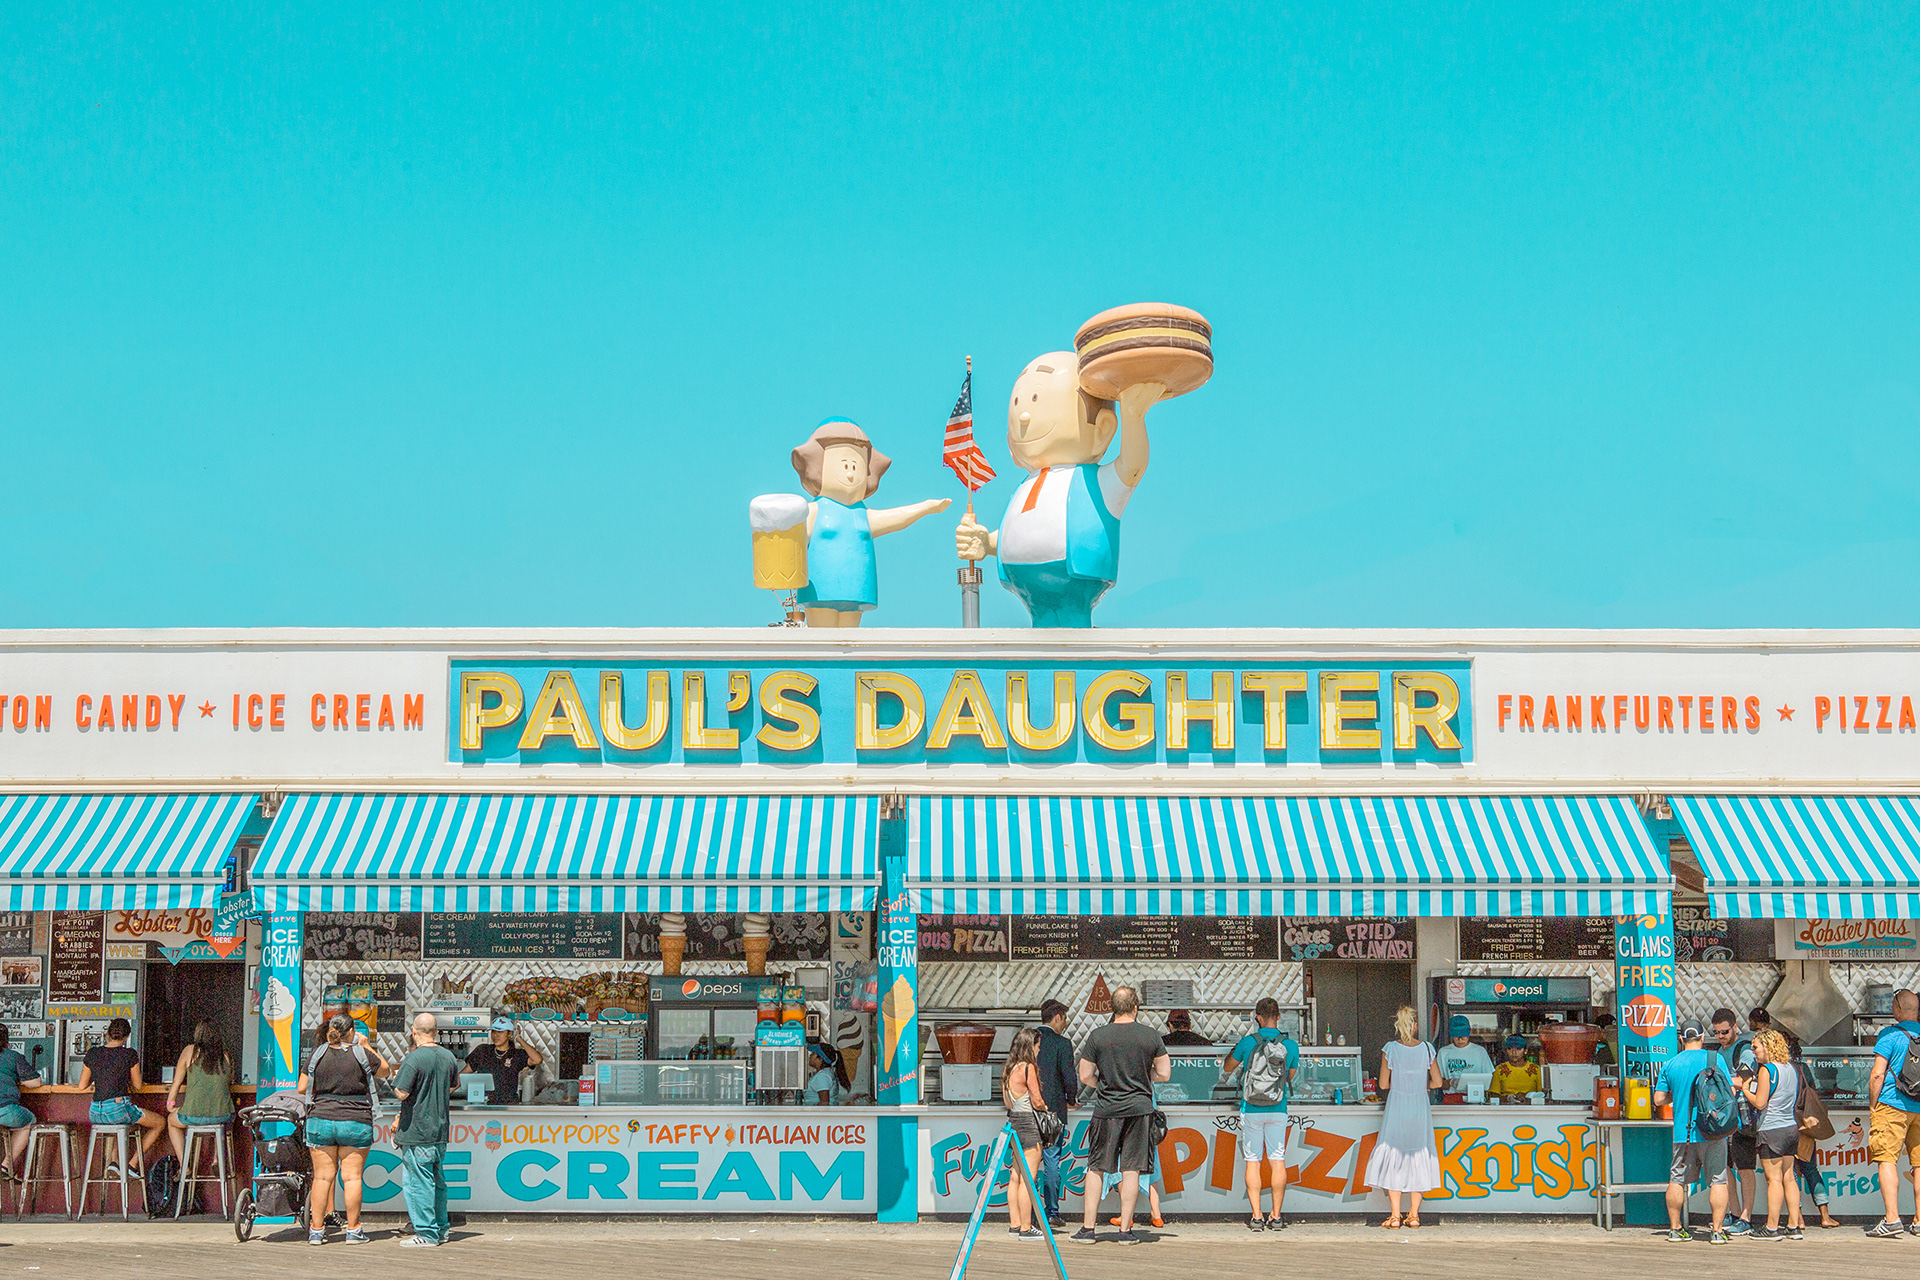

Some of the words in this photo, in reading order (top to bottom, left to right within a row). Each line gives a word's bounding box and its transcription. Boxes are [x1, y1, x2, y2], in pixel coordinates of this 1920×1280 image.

[75, 693, 186, 728] CANDY
[232, 693, 286, 727] ICE
[311, 692, 424, 727] CREAM
[460, 670, 821, 750] PAUL'S
[854, 670, 1464, 750] DAUGHTER
[1497, 694, 1761, 729] FRANKFURTERS
[1814, 694, 1917, 729] PIZZA
[217, 896, 250, 916] Lobster
[430, 913, 445, 921] ICE
[446, 913, 476, 921] CREAM
[881, 916, 910, 924] serve
[1585, 918, 1607, 926] SODA
[1345, 922, 1396, 940] FRIED
[1675, 919, 1728, 932] STRIPS
[266, 929, 299, 944] ICE
[881, 929, 916, 944] ICE
[1283, 926, 1331, 947] Cakes
[1800, 919, 1864, 948] Lobster
[1857, 919, 1911, 944] Rolls
[354, 929, 420, 953] Slushies
[953, 928, 1009, 954] PIZZA
[1490, 943, 1515, 952] FRIED
[1618, 935, 1672, 958] CLAMS
[107, 945, 144, 958] WINE
[262, 944, 302, 968] CREAM
[491, 945, 522, 954] ITALIAN
[525, 945, 544, 954] ICES
[877, 945, 918, 968] CREAM
[1013, 946, 1044, 954] FRENCH
[1046, 946, 1069, 954] FRIES
[1481, 952, 1509, 960] FRENCH
[1509, 952, 1535, 960] FRIES
[1848, 949, 1873, 958] FORGET
[1884, 949, 1900, 958] REST
[355, 974, 387, 982] NITRO
[1619, 964, 1674, 988] FRIES
[371, 981, 398, 990] BREW
[703, 982, 742, 996] pepsi
[1509, 984, 1543, 997] pepsi
[48, 1006, 133, 1017] MARGARITA
[1087, 999, 1112, 1011] SLICE
[1620, 1004, 1675, 1027] PIZZA
[1636, 1045, 1651, 1055] ALL
[1651, 1045, 1669, 1055] BEEF
[1170, 1059, 1211, 1068] UNNEL
[1317, 1058, 1351, 1068] SLICE
[1817, 1060, 1844, 1068] PEPPERS
[259, 1076, 297, 1089] Delicious
[878, 1070, 917, 1092] Delicious
[503, 1124, 620, 1145] LOLLYPOPS
[645, 1124, 721, 1144] TAFFY
[740, 1124, 821, 1144] ITALIAN
[826, 1124, 866, 1144] ICES
[1422, 1123, 1620, 1200] Knish
[338, 1150, 472, 1204] CE
[496, 1149, 865, 1202] CREAM
[1820, 1170, 1881, 1197] Fries
